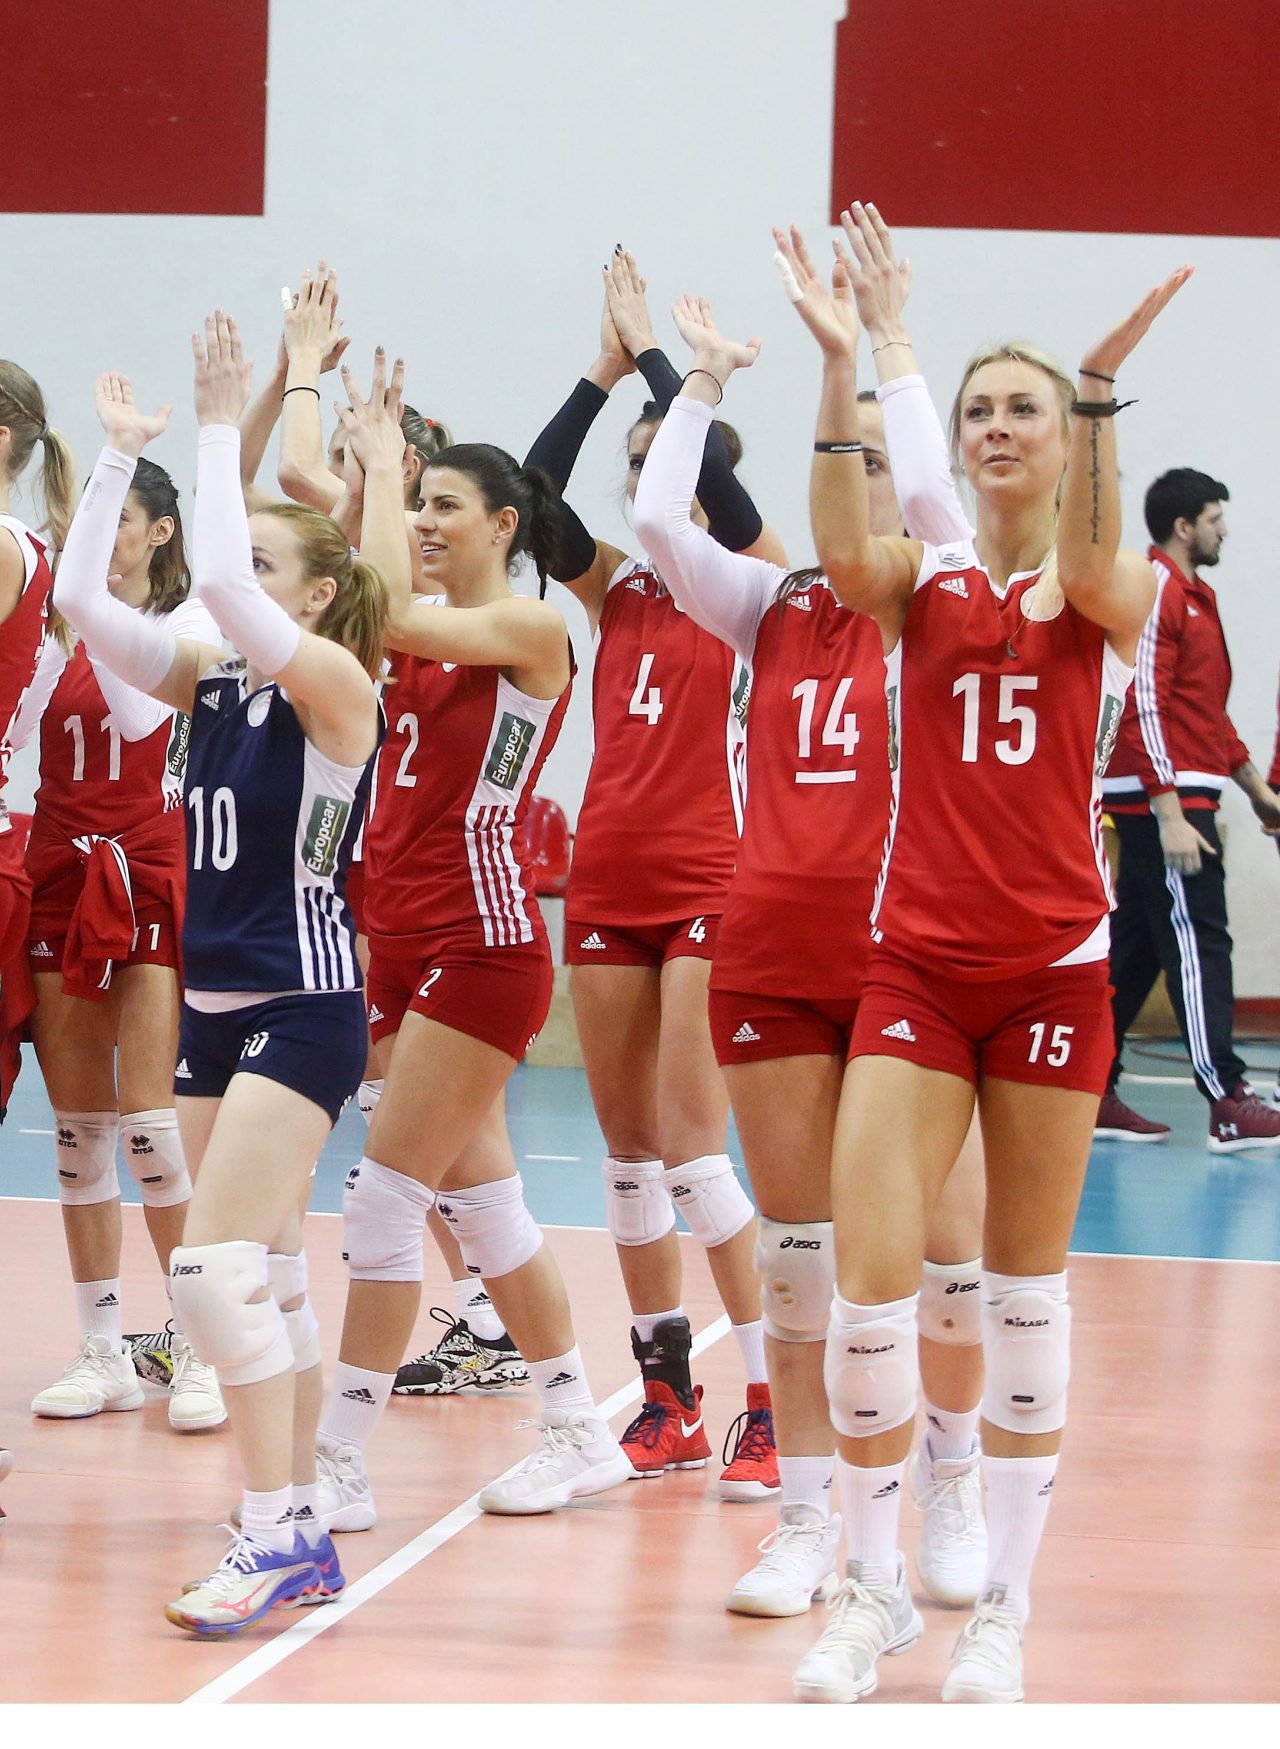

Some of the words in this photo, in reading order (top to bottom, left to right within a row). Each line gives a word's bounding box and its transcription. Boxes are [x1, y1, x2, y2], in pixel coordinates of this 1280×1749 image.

[938, 581, 969, 599] adidas
[628, 653, 663, 725] 4
[791, 677, 860, 758] 14
[63, 713, 121, 782] 11
[169, 714, 191, 773] Europcar
[952, 673, 1038, 766] 15
[395, 712, 419, 788] 2
[491, 718, 523, 785] Europcar
[188, 786, 239, 872] 10
[306, 800, 337, 873] Europcar
[580, 942, 607, 950] adidas
[688, 917, 706, 943] 4
[418, 968, 443, 998] 2
[732, 1033, 761, 1043] adidas
[881, 1027, 917, 1042] adidas
[1027, 1022, 1075, 1068] 15
[341, 1391, 377, 1405] adidas
